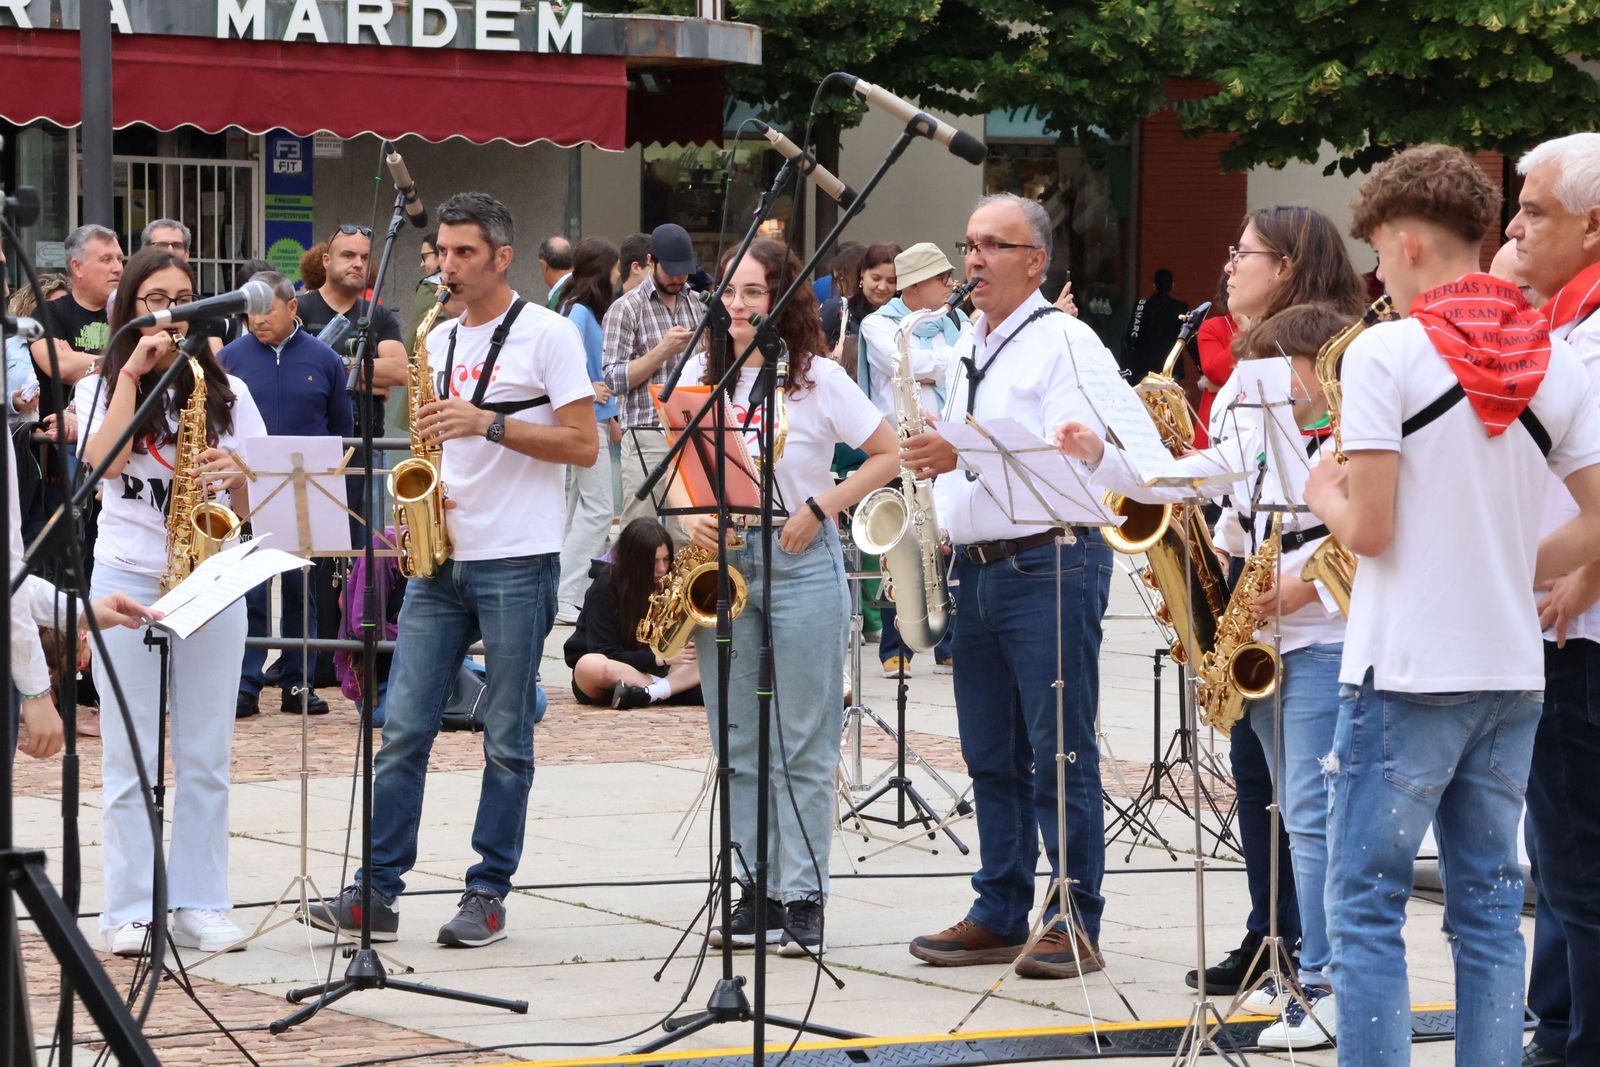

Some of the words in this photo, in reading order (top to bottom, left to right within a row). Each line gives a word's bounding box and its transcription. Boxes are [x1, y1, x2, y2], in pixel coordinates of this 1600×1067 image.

[216, 0, 583, 54] MARDEM
[278, 161, 298, 171] FIT
[1424, 282, 1480, 304] FERIAS
[1483, 283, 1493, 294] Y
[1468, 308, 1498, 318] SAN
